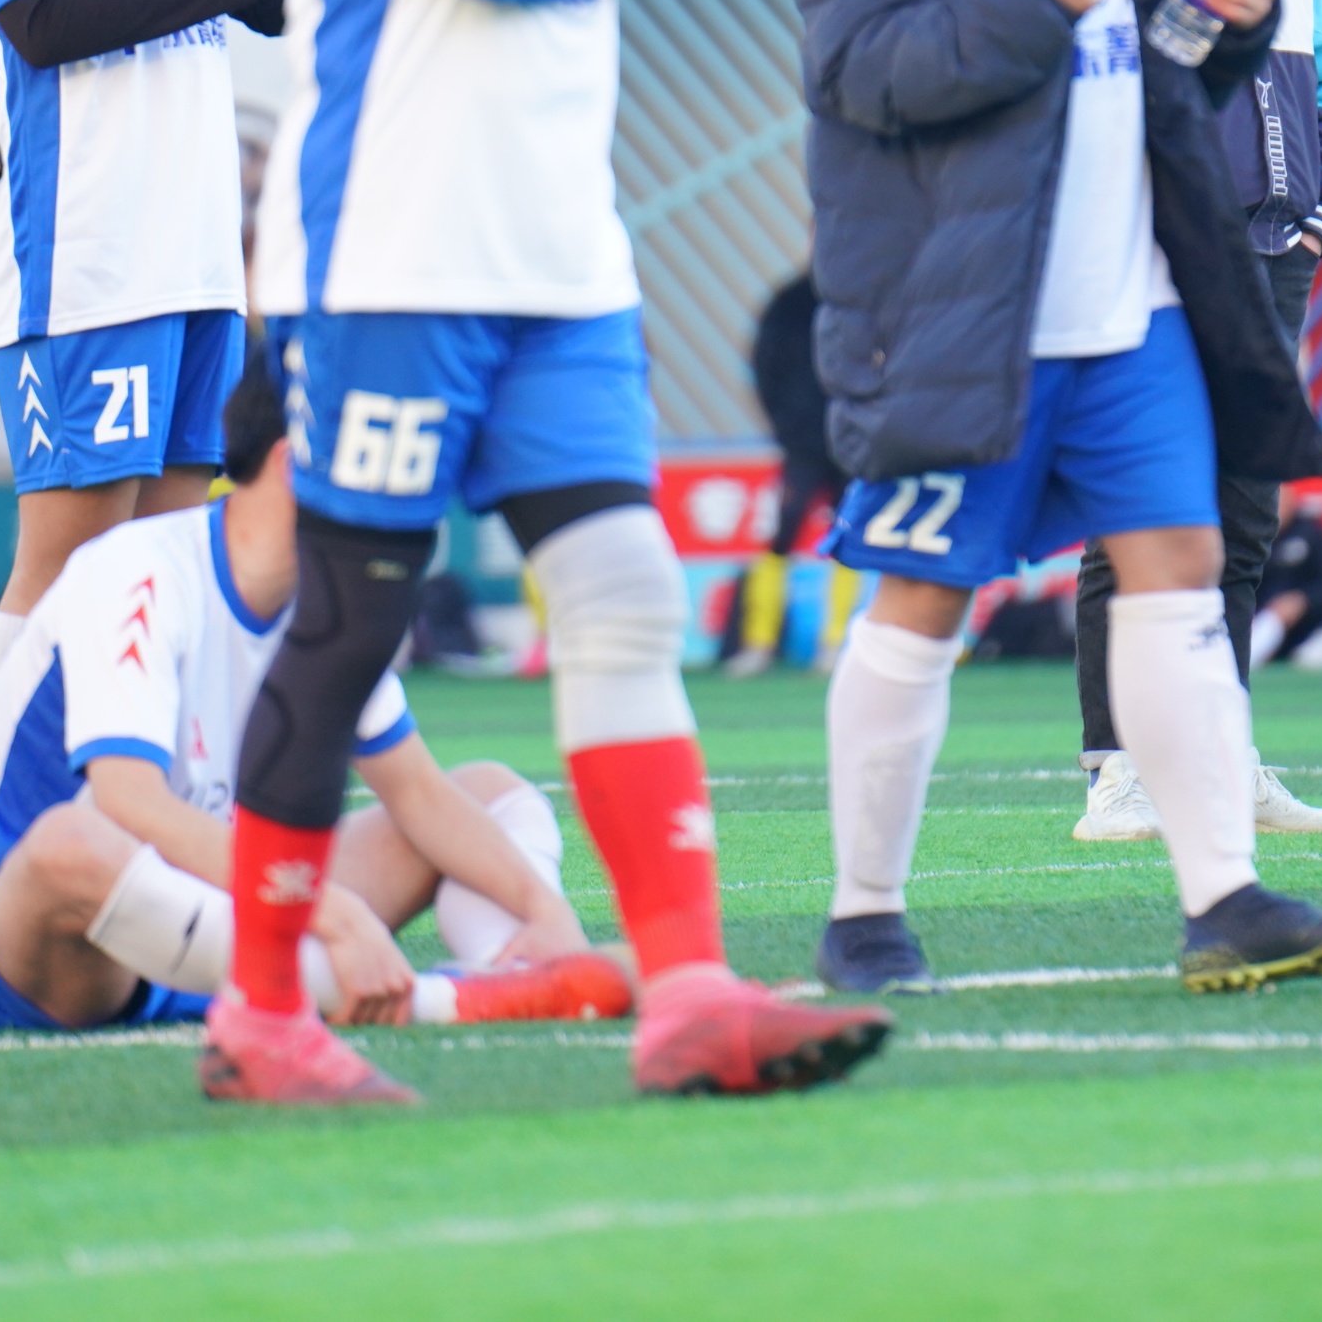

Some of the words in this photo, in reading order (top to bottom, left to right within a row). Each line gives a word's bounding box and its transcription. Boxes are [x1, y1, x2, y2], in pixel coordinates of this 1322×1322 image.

[1265, 115, 1288, 195] PUMA
[91, 364, 150, 444] 21
[330, 389, 449, 496] 66
[863, 473, 967, 554] 22
